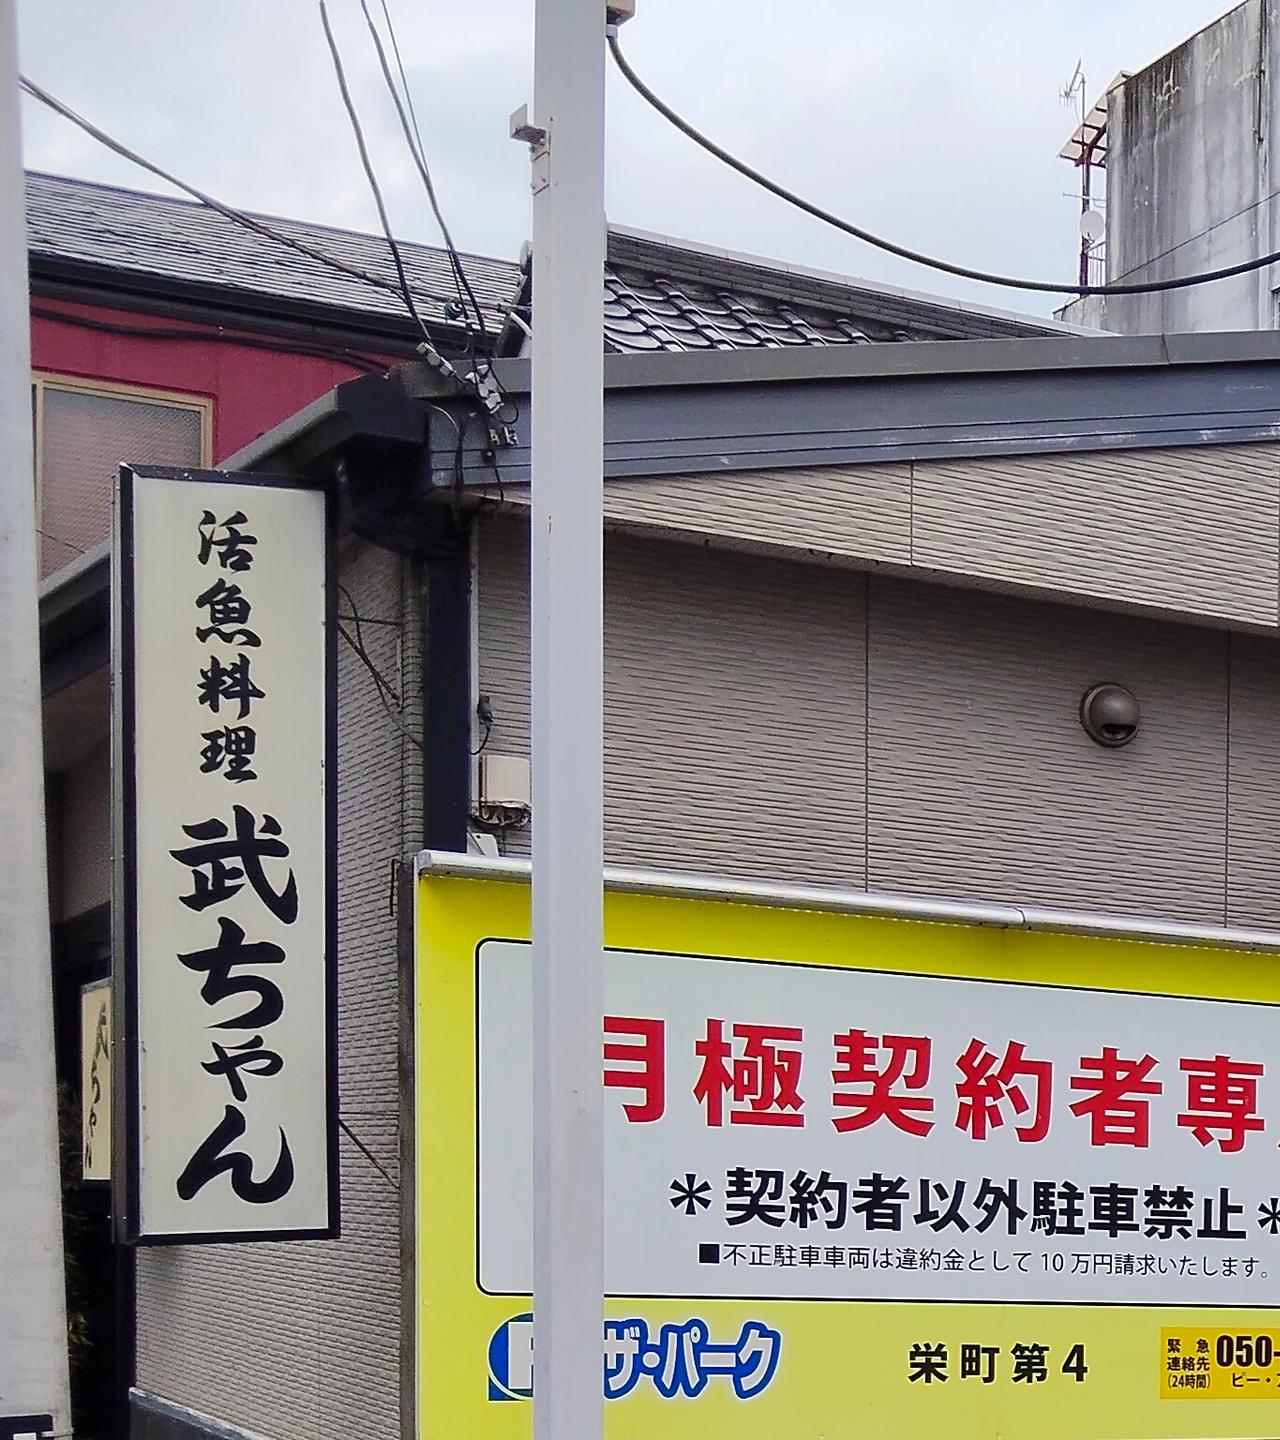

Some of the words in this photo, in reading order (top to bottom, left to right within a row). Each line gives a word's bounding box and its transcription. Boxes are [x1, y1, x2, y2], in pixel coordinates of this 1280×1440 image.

[195, 510, 266, 784] 活魚料理
[169, 804, 299, 1204] 武ちゃん
[908, 1343, 1088, 1383] 栄町第4
[1166, 1356, 1210, 1371] 連絡先
[1168, 1373, 1211, 1389] (24時間)
